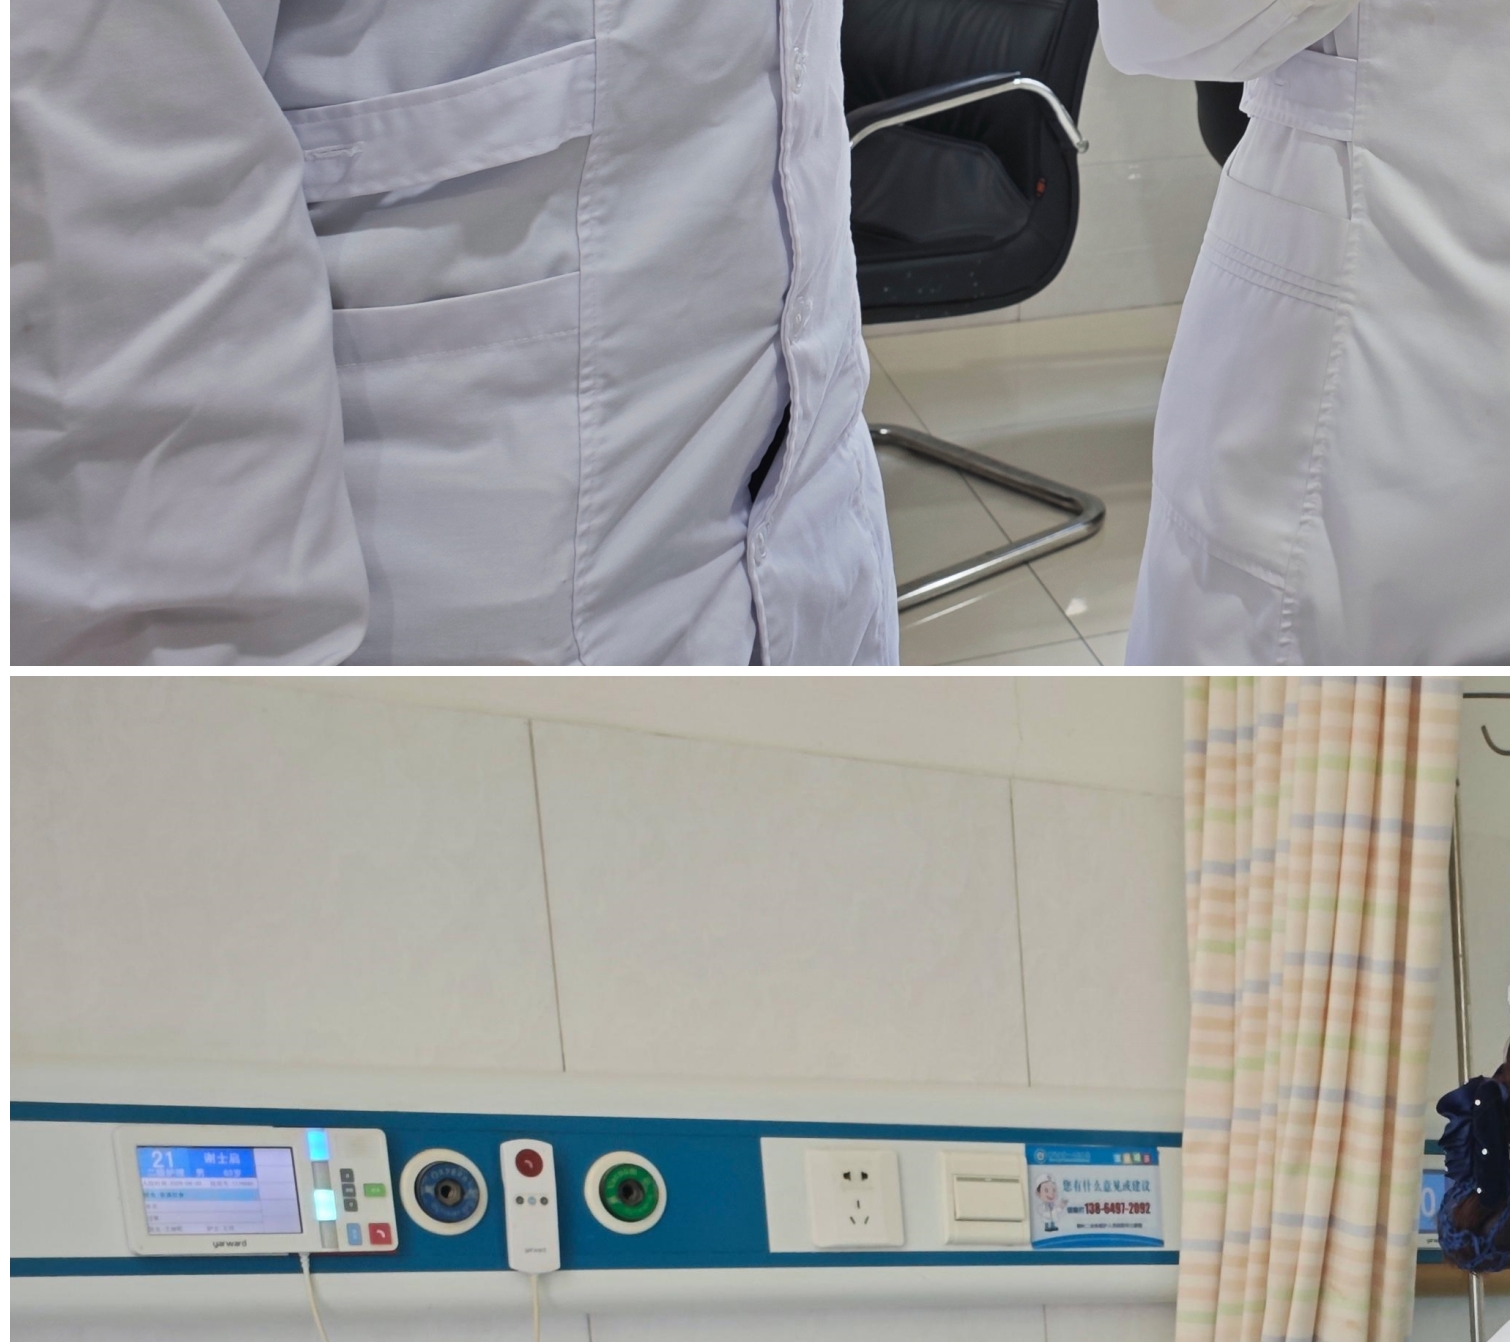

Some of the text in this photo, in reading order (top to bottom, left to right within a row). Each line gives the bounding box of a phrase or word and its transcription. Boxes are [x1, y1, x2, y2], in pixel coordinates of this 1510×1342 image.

[151, 1150, 174, 1168] 21
[1062, 1179, 1151, 1193] 您有什么意见或建议
[212, 1239, 247, 1248] yarward
